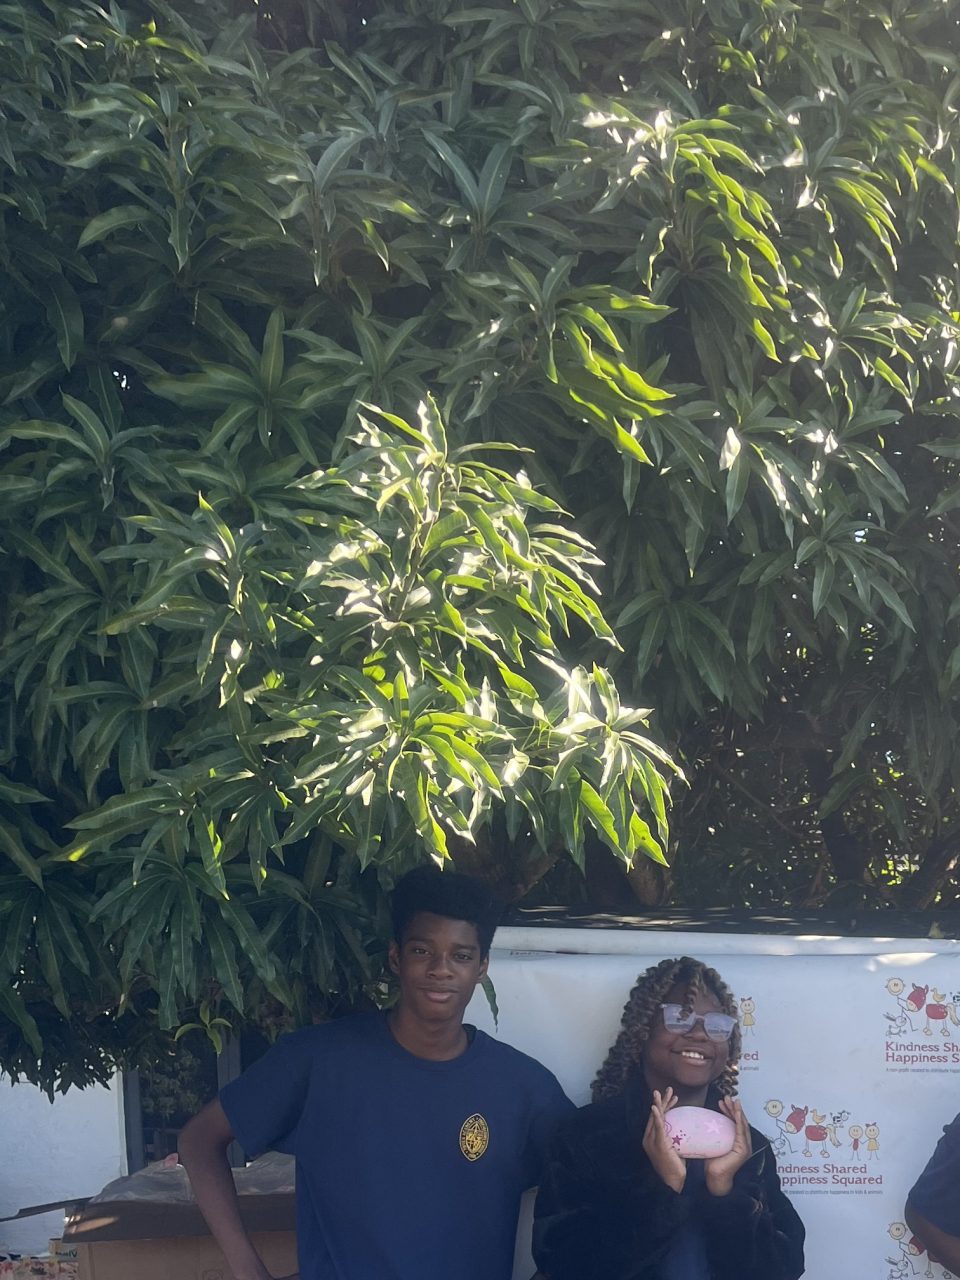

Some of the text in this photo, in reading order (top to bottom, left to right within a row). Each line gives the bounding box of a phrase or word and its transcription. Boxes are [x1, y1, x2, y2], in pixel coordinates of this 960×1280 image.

[885, 1041, 939, 1052] Kindness
[885, 1052, 948, 1065] Happiness
[777, 1163, 867, 1174] ndness Shared
[779, 1174, 883, 1187] ppiness Squared
